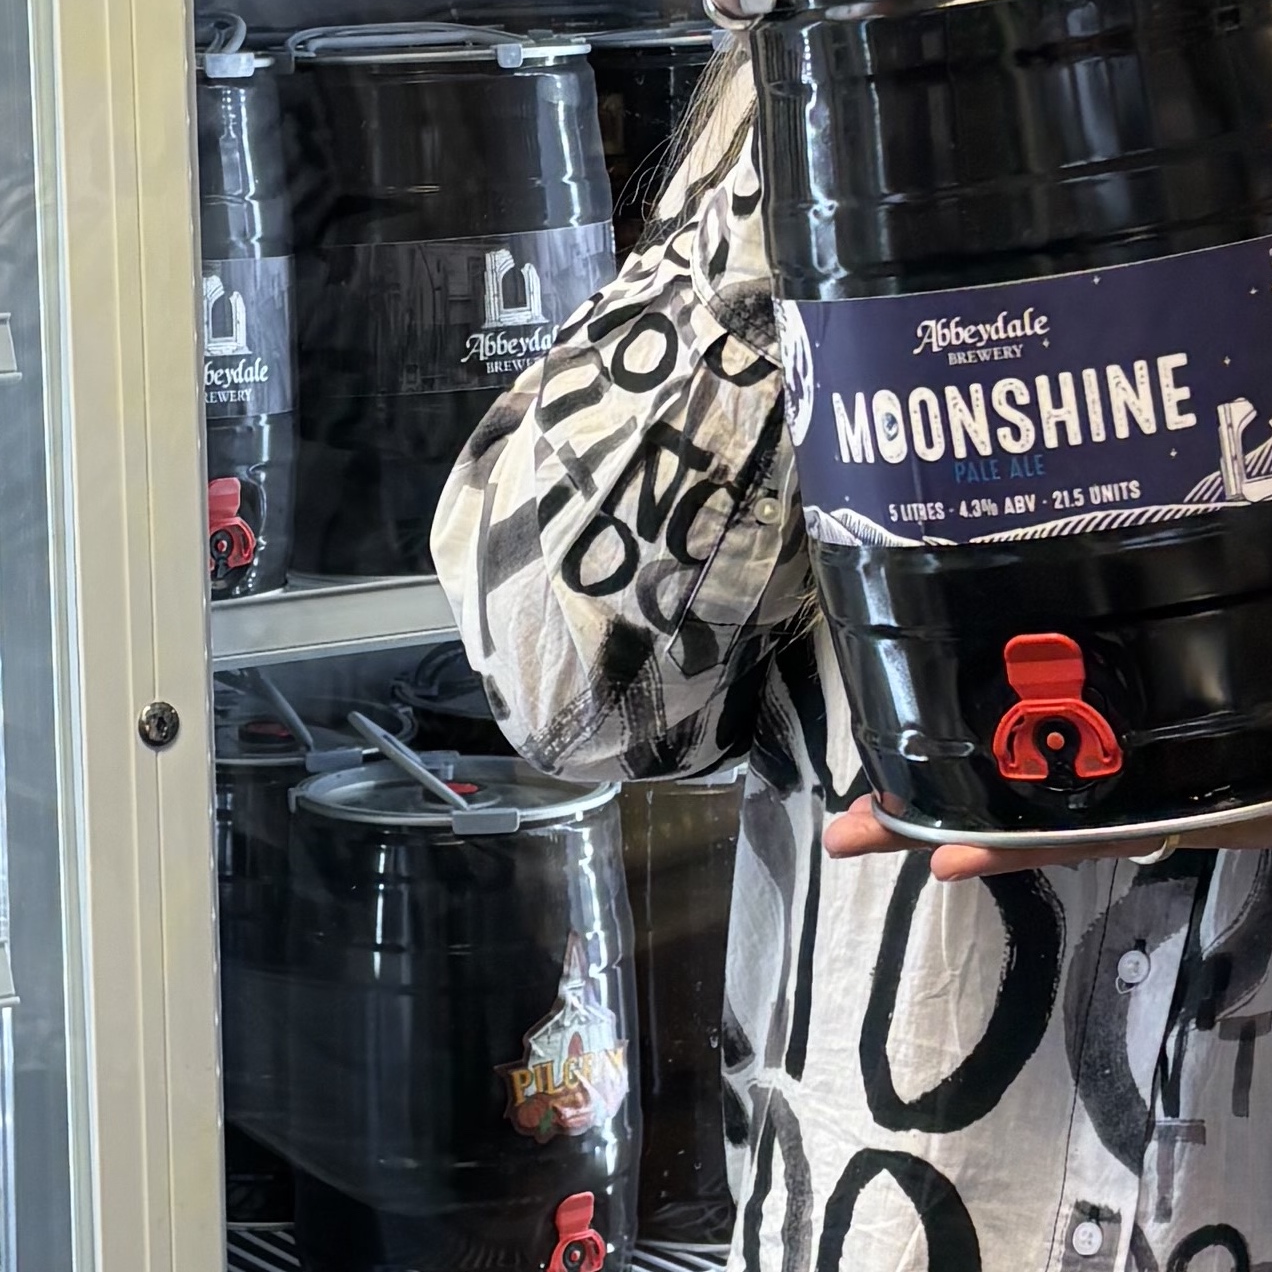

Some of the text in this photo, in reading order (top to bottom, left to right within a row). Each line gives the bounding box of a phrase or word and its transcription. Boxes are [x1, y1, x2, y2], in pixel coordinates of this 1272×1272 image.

[912, 307, 1050, 355] Abbeydale
[948, 344, 1024, 366] BREWERY
[832, 352, 1197, 465] MOONSHINE
[954, 454, 1047, 484] PALE ALE
[889, 480, 1142, 522] 5 LITRES 4.3% ABV 21.5 UNITS
